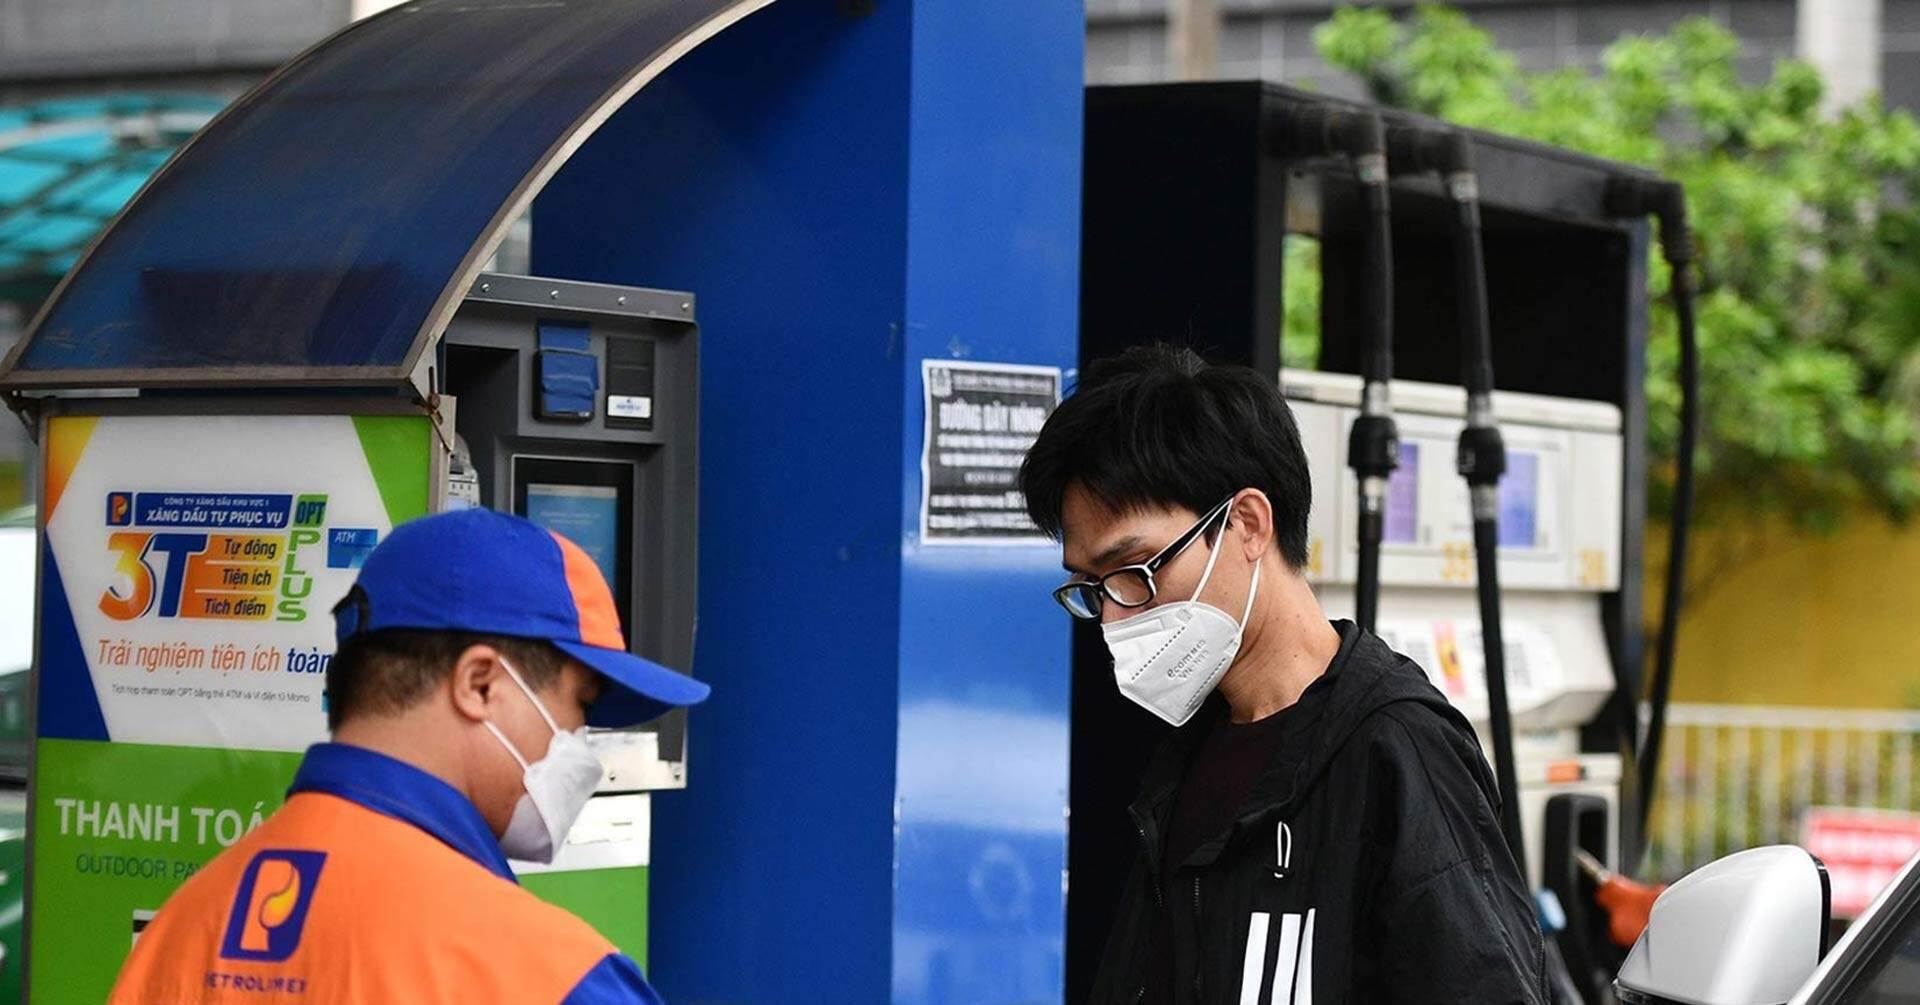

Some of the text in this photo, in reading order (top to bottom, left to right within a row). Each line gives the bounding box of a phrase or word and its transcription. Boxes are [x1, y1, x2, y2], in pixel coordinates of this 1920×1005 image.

[210, 511, 228, 526] TỰ
[229, 511, 263, 527] PHỤC
[266, 512, 283, 527] VỤ
[335, 531, 356, 543] ATM
[223, 539, 277, 560] Tự động
[222, 568, 271, 589] Tiện ích
[204, 597, 266, 616] Tích điểm
[99, 639, 132, 665] Trải
[136, 642, 204, 674] nghiệm
[210, 644, 246, 677] tiện
[251, 647, 281, 672] ích
[54, 797, 180, 844] THANH
[76, 853, 167, 879] OUTDOOR
